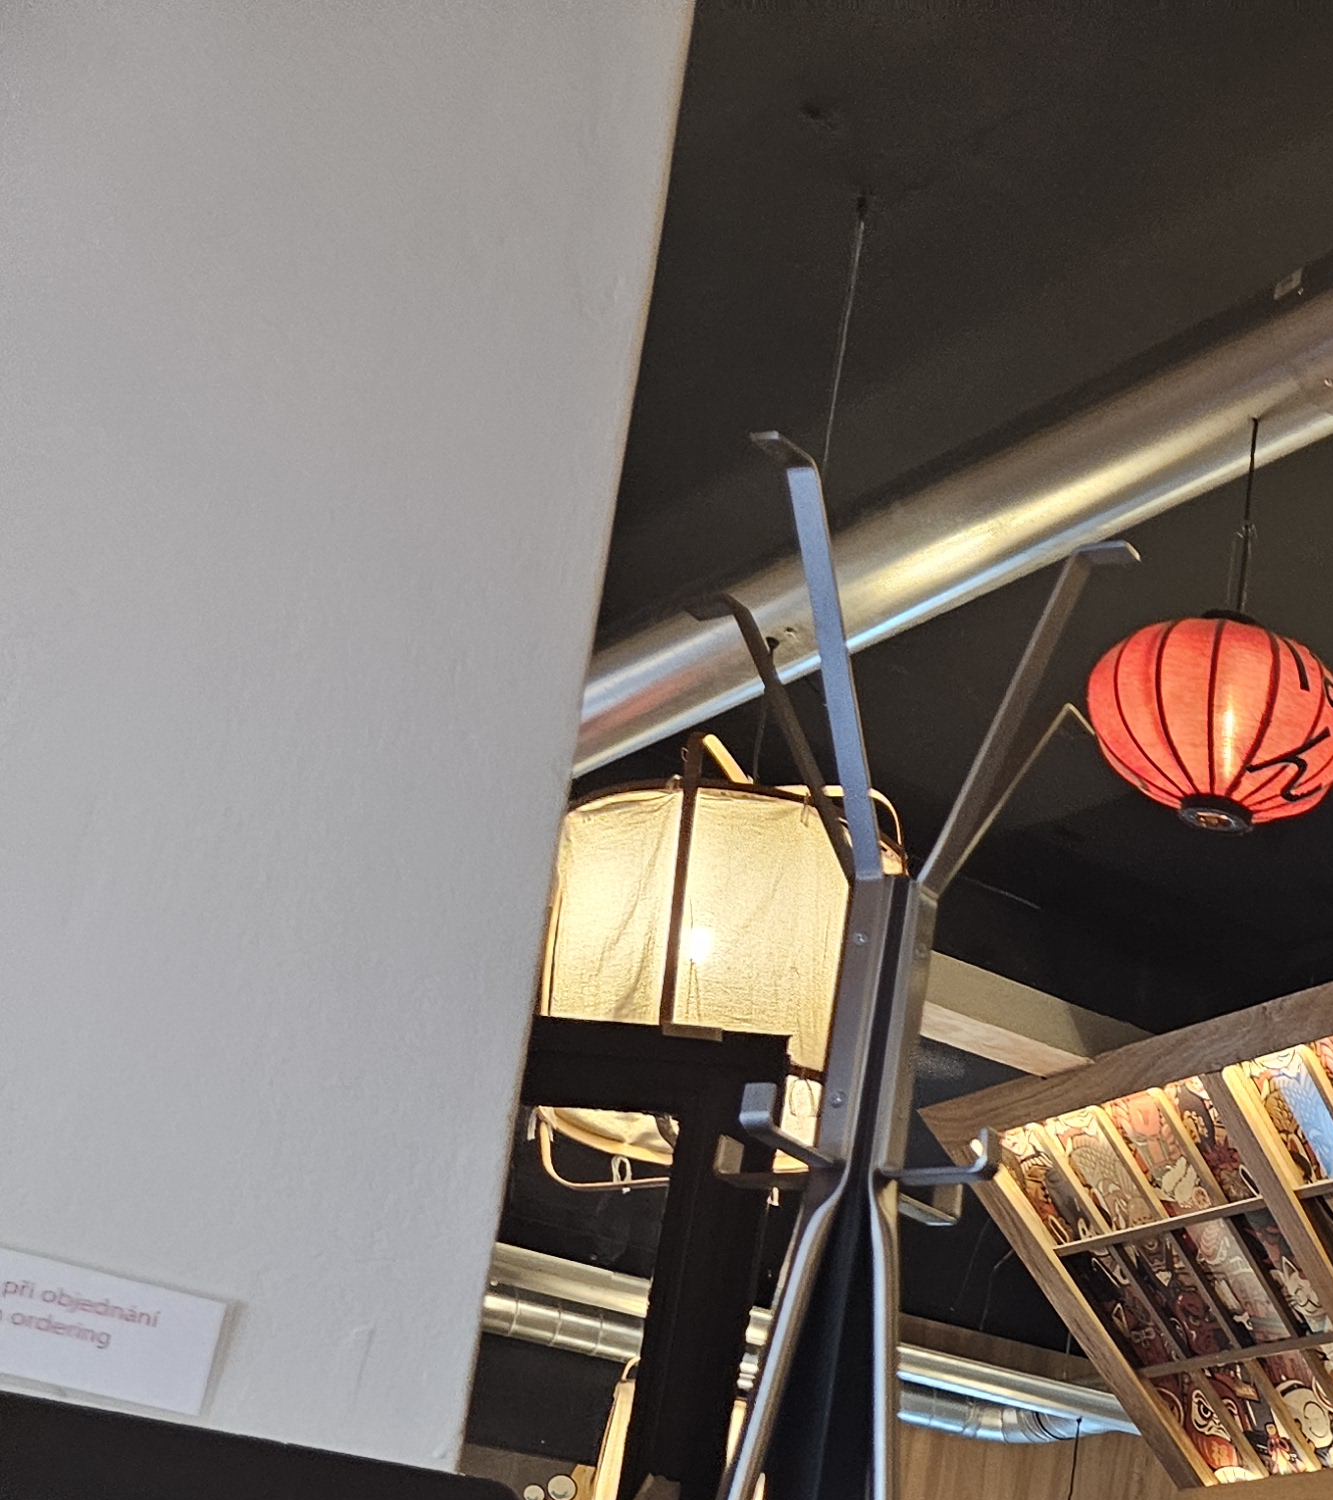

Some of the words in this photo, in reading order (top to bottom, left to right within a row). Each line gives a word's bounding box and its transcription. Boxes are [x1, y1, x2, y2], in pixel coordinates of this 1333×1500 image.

[2, 1279, 35, 1300] při
[41, 1287, 162, 1328] objednání
[11, 1312, 112, 1350] ordering
